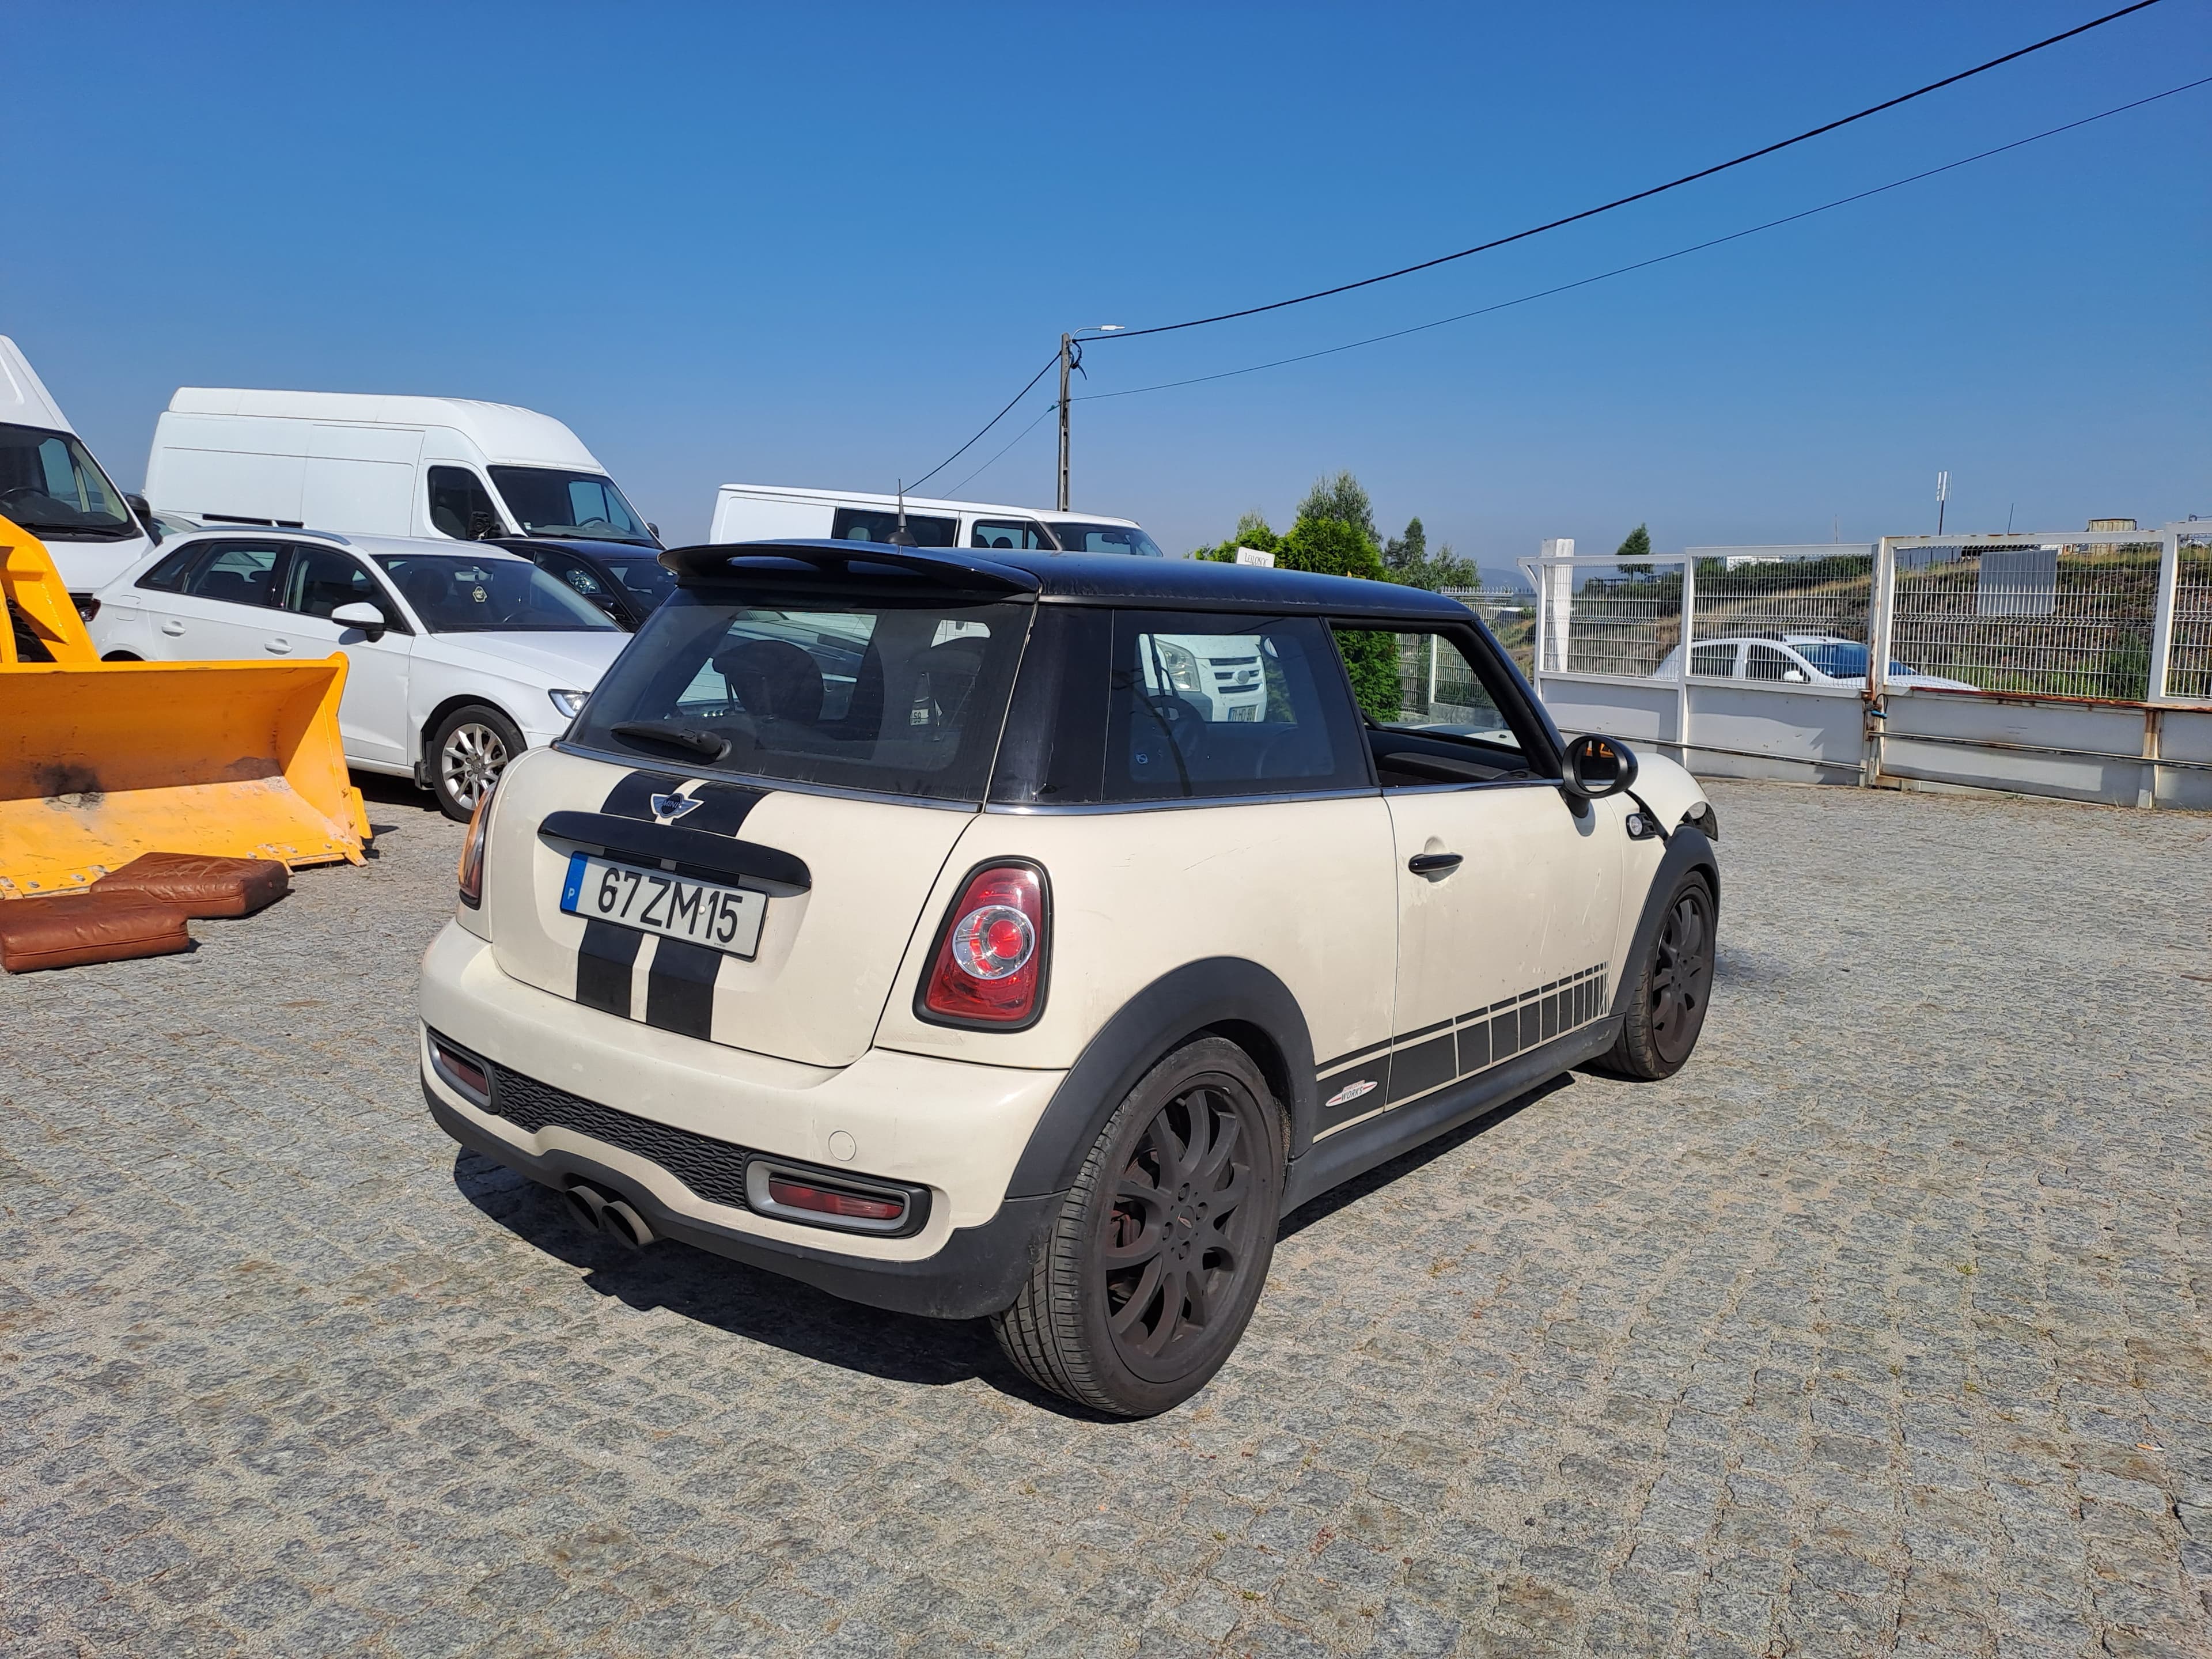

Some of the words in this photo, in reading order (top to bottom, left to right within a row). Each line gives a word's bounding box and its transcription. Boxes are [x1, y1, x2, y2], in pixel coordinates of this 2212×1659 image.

[662, 800, 679, 808] MINI
[567, 888, 575, 900] P
[1342, 1086, 1363, 1101] WORKS
